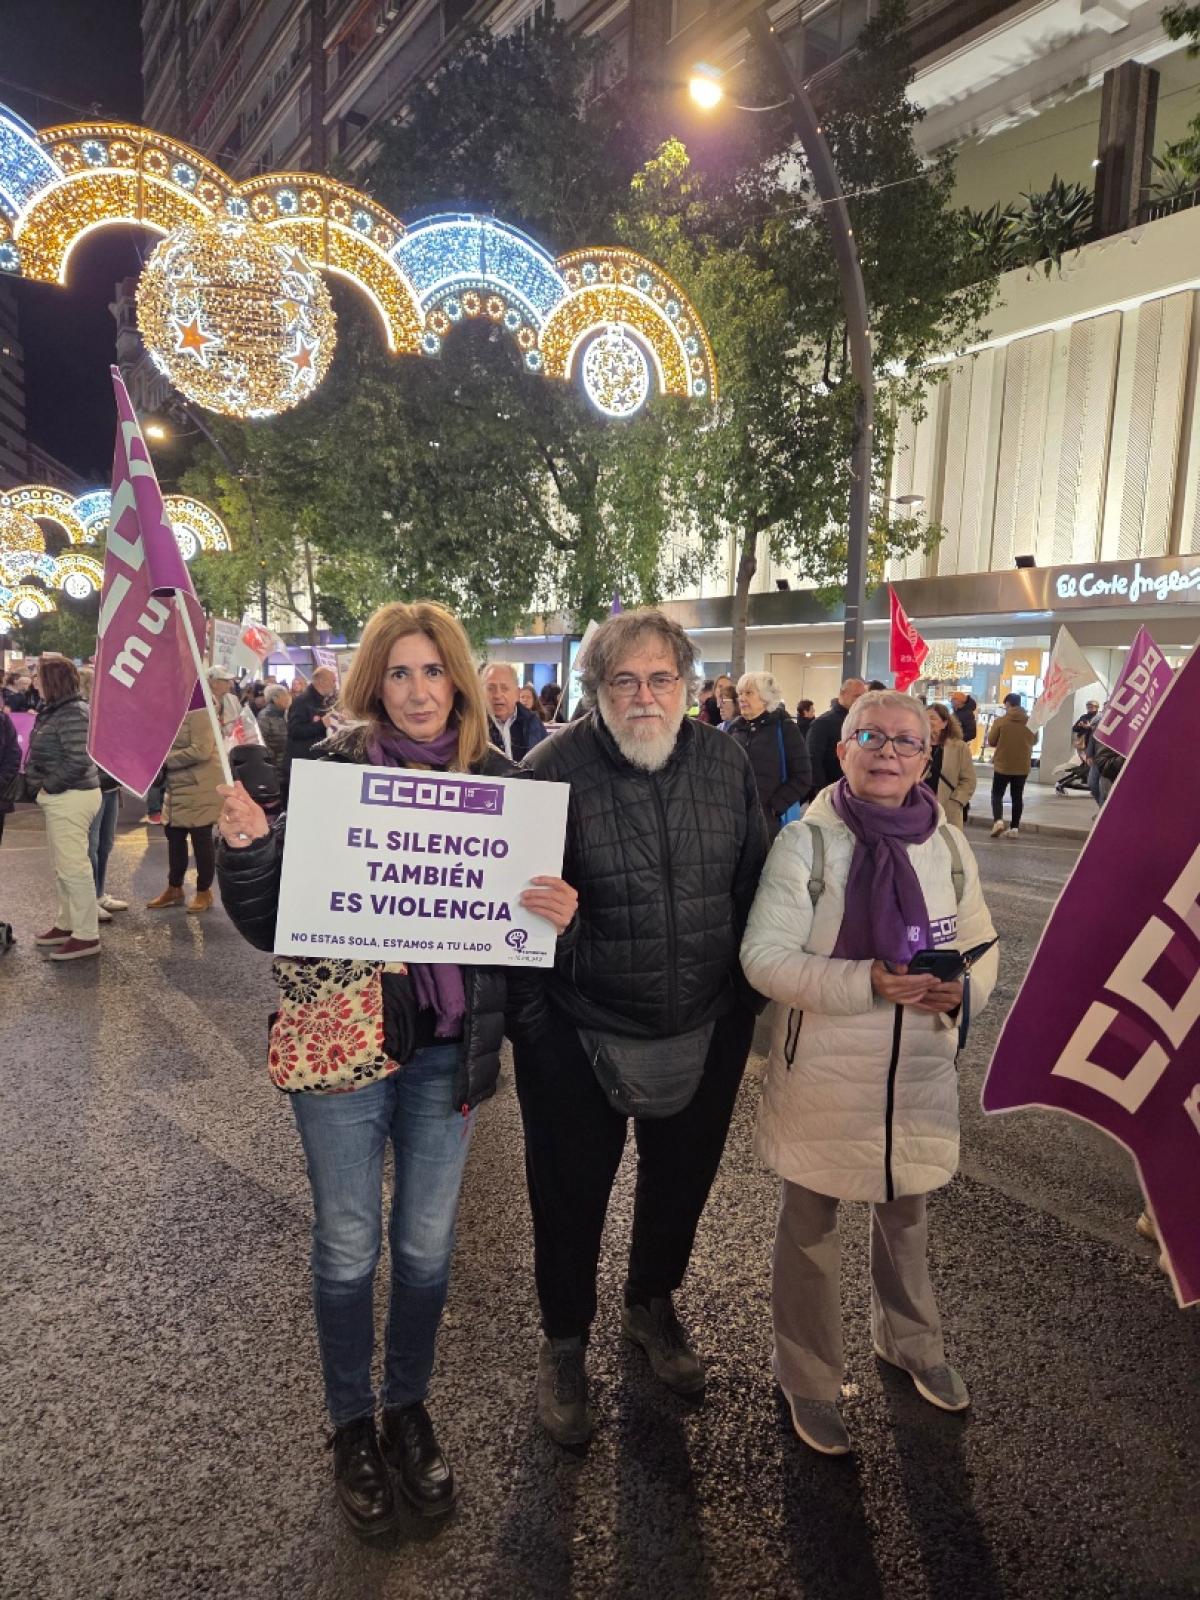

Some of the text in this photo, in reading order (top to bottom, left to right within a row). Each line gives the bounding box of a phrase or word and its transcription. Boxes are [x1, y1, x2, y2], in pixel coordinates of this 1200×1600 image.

[1056, 574, 1078, 598] El
[1079, 572, 1129, 597] Corte
[1097, 646, 1162, 735] CCOO
[368, 778, 462, 807] CCOO
[347, 827, 510, 859] EL SILENCIO
[367, 862, 484, 890] TAMBIÉN
[329, 891, 512, 922] ES VIOLENCIA
[291, 932, 308, 943] NO
[310, 934, 346, 946] ESTAS
[383, 938, 435, 950] ESTAMOS
[436, 940, 445, 951] A
[447, 941, 462, 951] TU
[463, 942, 493, 952] LADO
